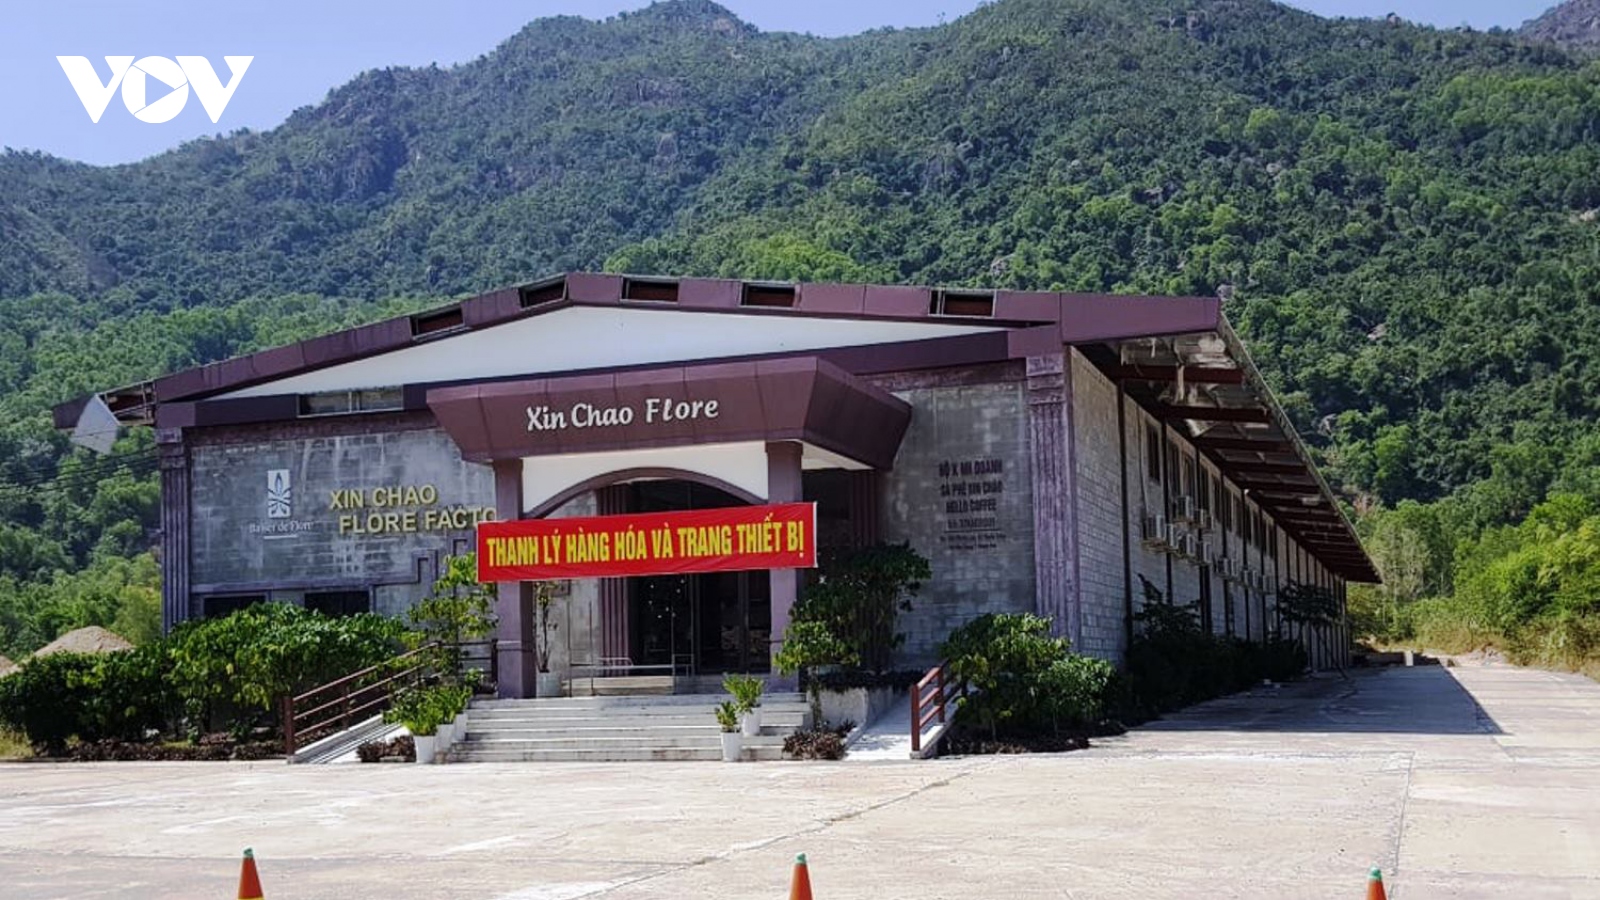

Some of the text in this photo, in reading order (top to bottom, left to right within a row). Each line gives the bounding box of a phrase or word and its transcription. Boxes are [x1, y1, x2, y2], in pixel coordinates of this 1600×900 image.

[526, 398, 719, 431] Xin Chao Flore
[330, 484, 436, 509] XIN CHAO
[339, 512, 417, 535] FLORE
[486, 512, 804, 567] THANH LÝ HÀNG HÓA VÀ TRANG THIẾT BỊ
